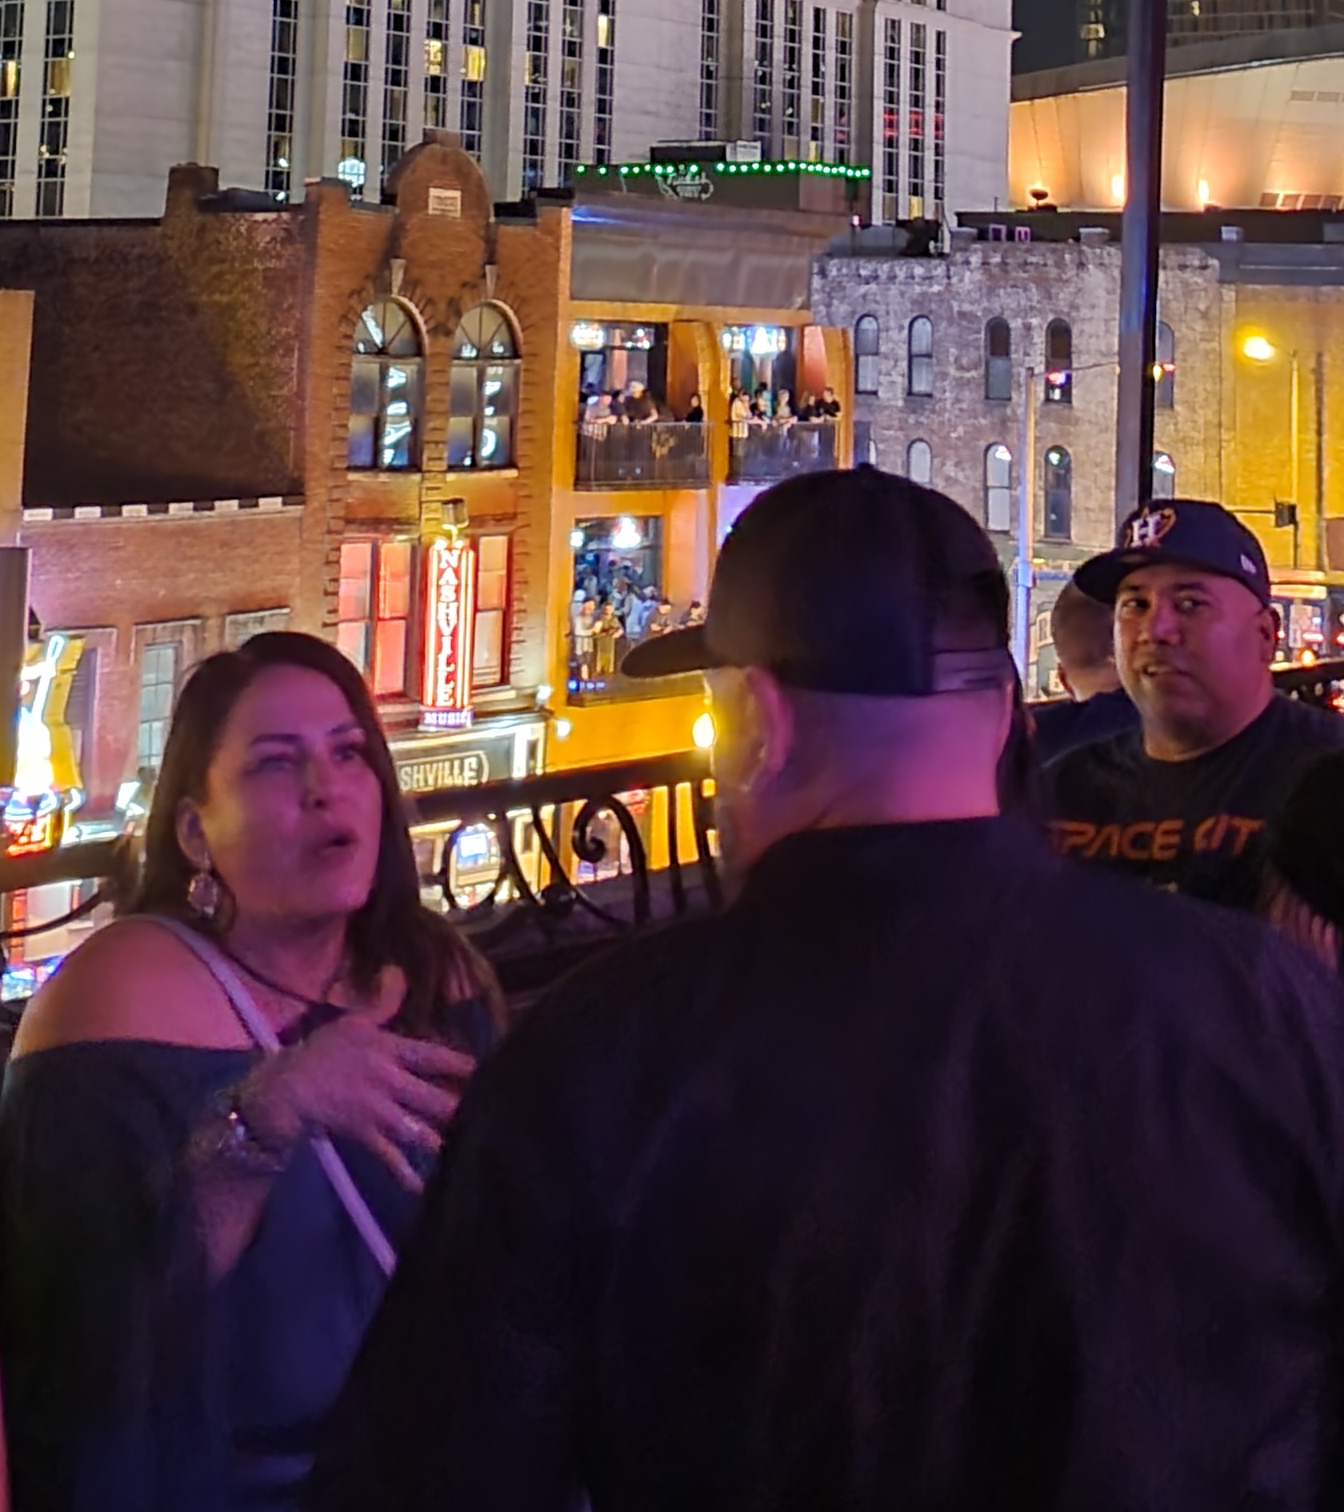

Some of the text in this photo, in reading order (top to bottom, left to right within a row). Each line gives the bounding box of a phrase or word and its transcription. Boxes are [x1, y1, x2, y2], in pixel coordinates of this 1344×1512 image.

[1130, 511, 1162, 549] H
[436, 548, 460, 707] NASHVILLE
[424, 711, 468, 727] MUSIC
[1047, 818, 1184, 862] PACE
